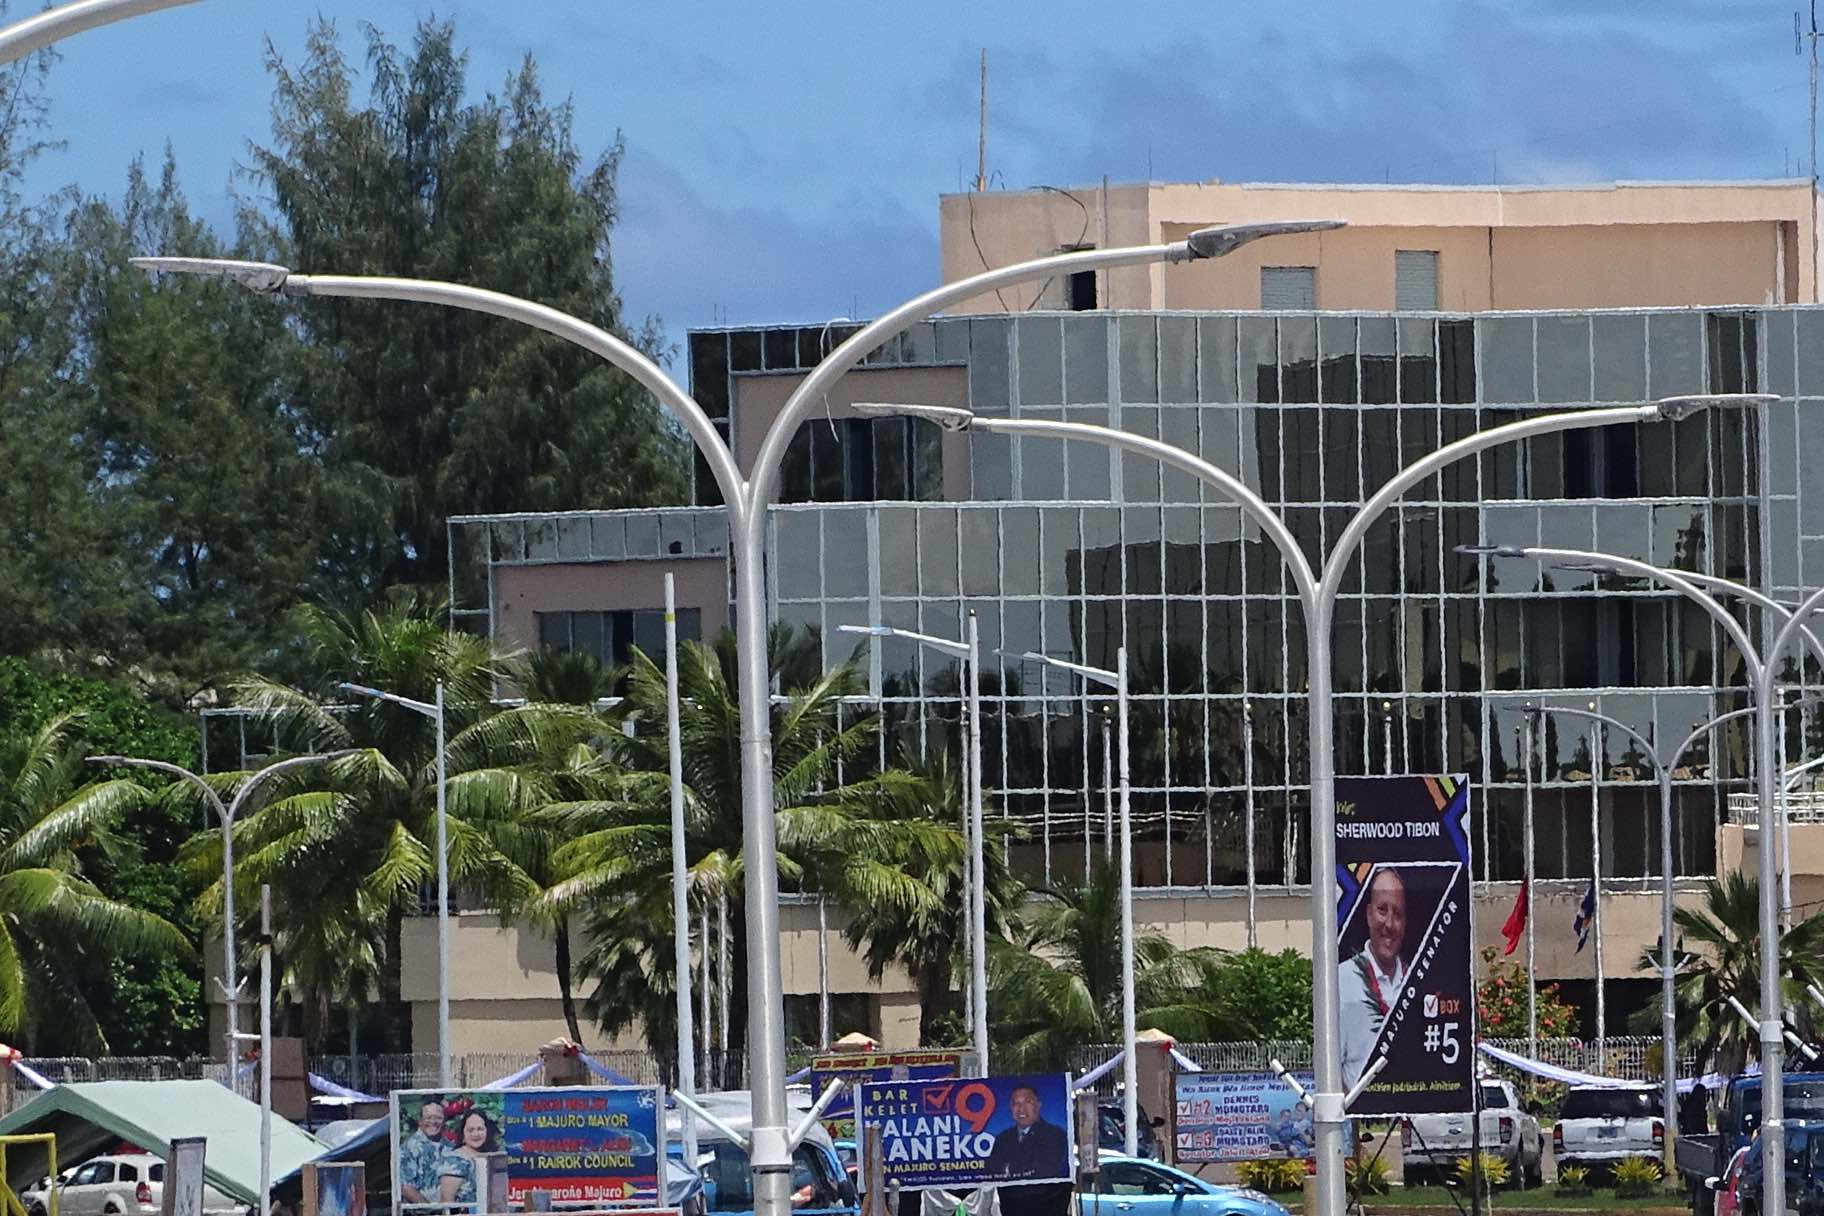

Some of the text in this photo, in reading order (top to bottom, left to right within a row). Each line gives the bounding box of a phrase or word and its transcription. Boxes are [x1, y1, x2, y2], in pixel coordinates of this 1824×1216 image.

[1336, 821, 1439, 838] SHERWOOD TIBON
[1379, 900, 1458, 1055] MAJURO SENATOR
[1440, 1000, 1460, 1014] BOX
[1424, 1022, 1460, 1064] #5
[872, 1089, 909, 1101] BAR
[1223, 1095, 1260, 1104] DENNIS
[864, 1102, 918, 1116] KELET
[955, 1082, 996, 1133] 9
[536, 1115, 585, 1128] MAJURO
[587, 1113, 629, 1127] MAYOR
[880, 1131, 996, 1163] ANEKO
[538, 1155, 583, 1169] RAIROK
[584, 1154, 635, 1168] COUNCIL
[894, 1162, 937, 1173] MAJURO
[939, 1159, 985, 1172] SENATOR
[584, 1184, 622, 1200] Majuro
